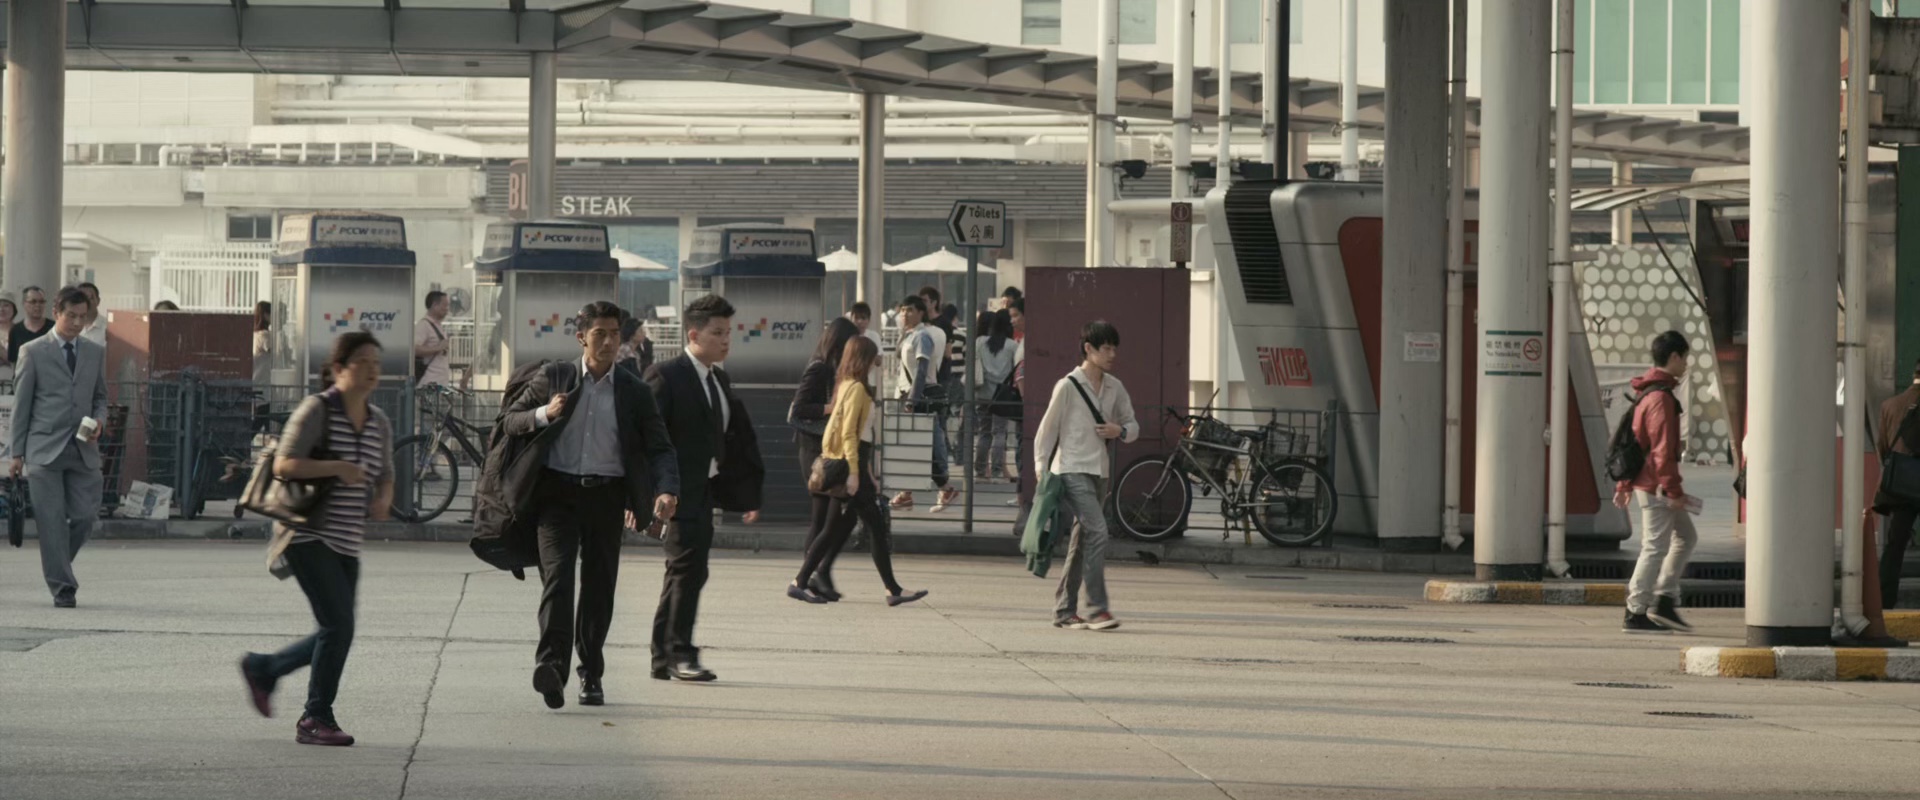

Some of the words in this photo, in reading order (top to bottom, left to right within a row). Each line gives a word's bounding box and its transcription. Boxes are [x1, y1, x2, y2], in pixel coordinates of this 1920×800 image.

[509, 172, 528, 210] BL
[561, 195, 632, 215] STEAK
[969, 206, 1000, 219] Toilets
[339, 227, 368, 235] PCCW
[752, 239, 780, 247] PCCW
[360, 312, 396, 321] PCCW
[772, 322, 806, 331] PCCW
